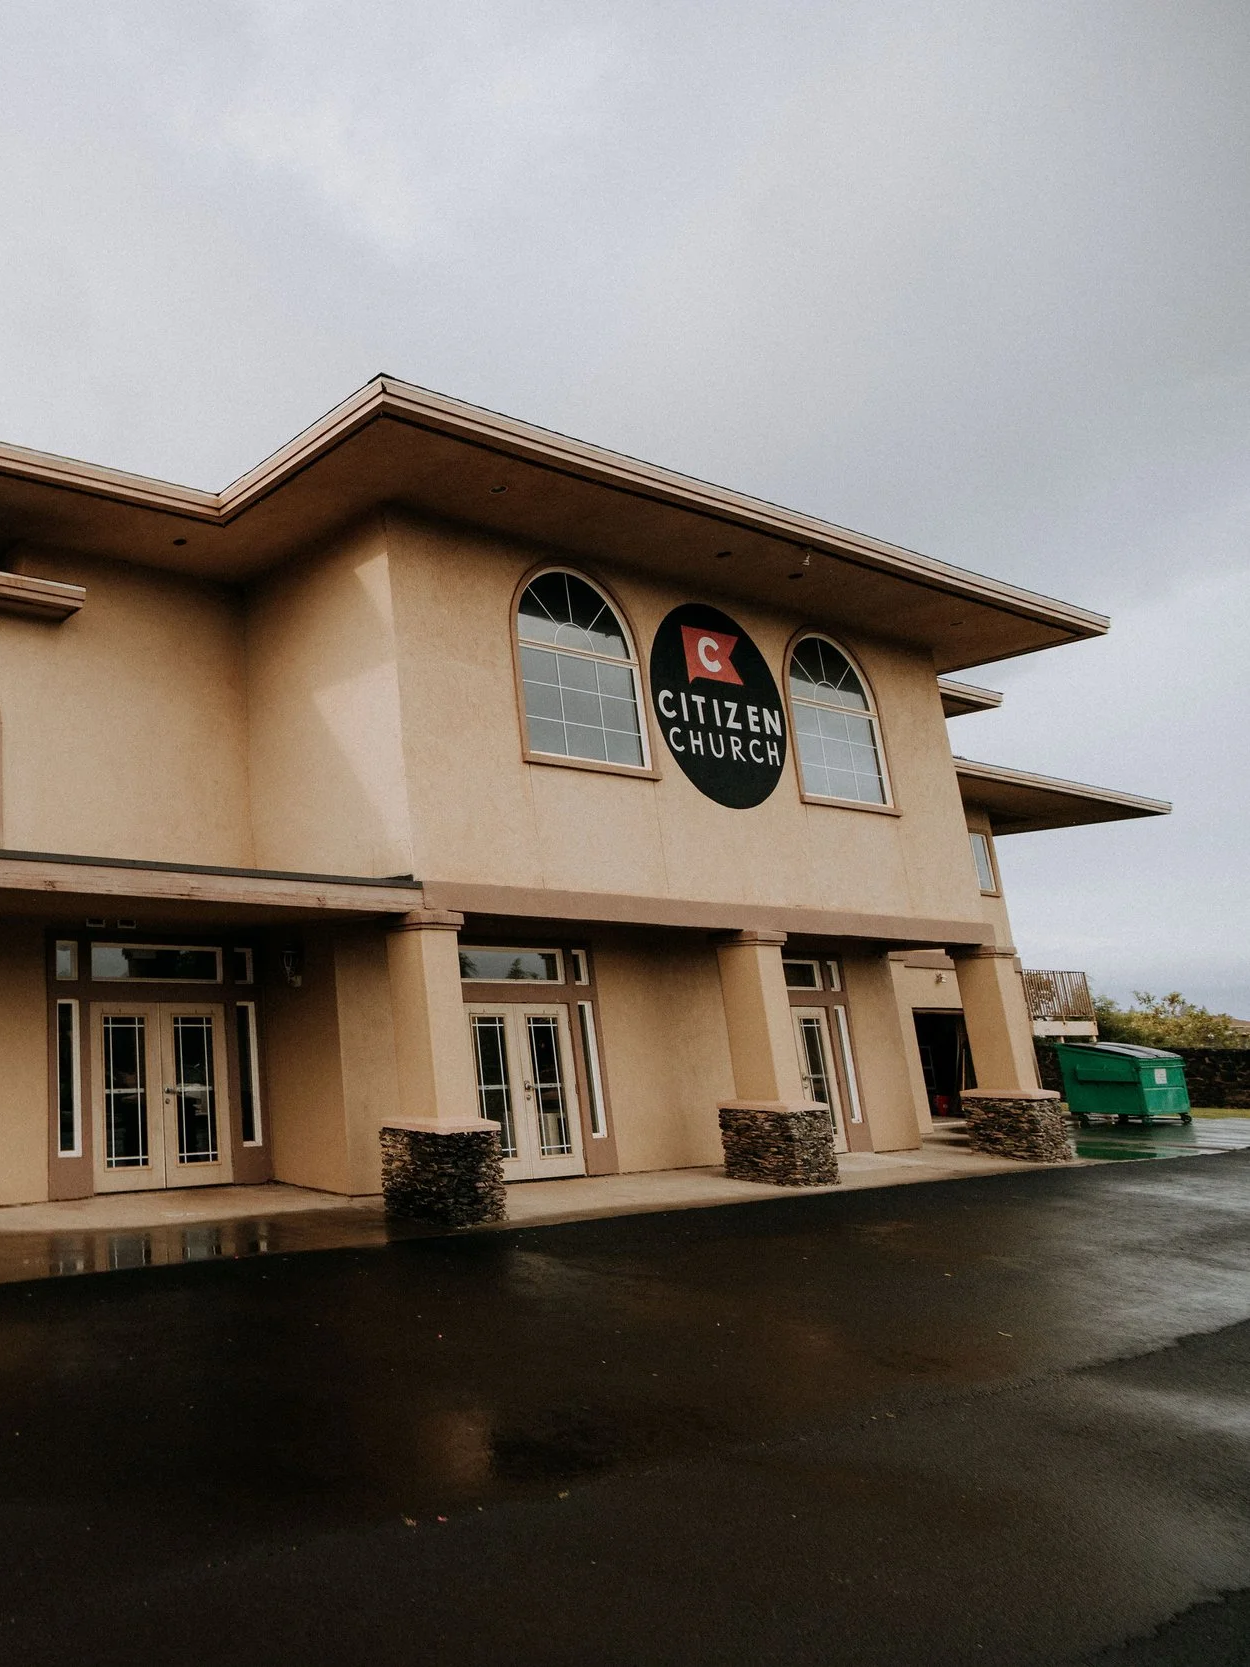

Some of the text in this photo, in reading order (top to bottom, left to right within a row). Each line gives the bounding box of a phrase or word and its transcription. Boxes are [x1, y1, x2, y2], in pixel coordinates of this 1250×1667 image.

[697, 636, 722, 673] C
[658, 689, 782, 736] CITIZEN
[669, 726, 780, 767] CHURCH
